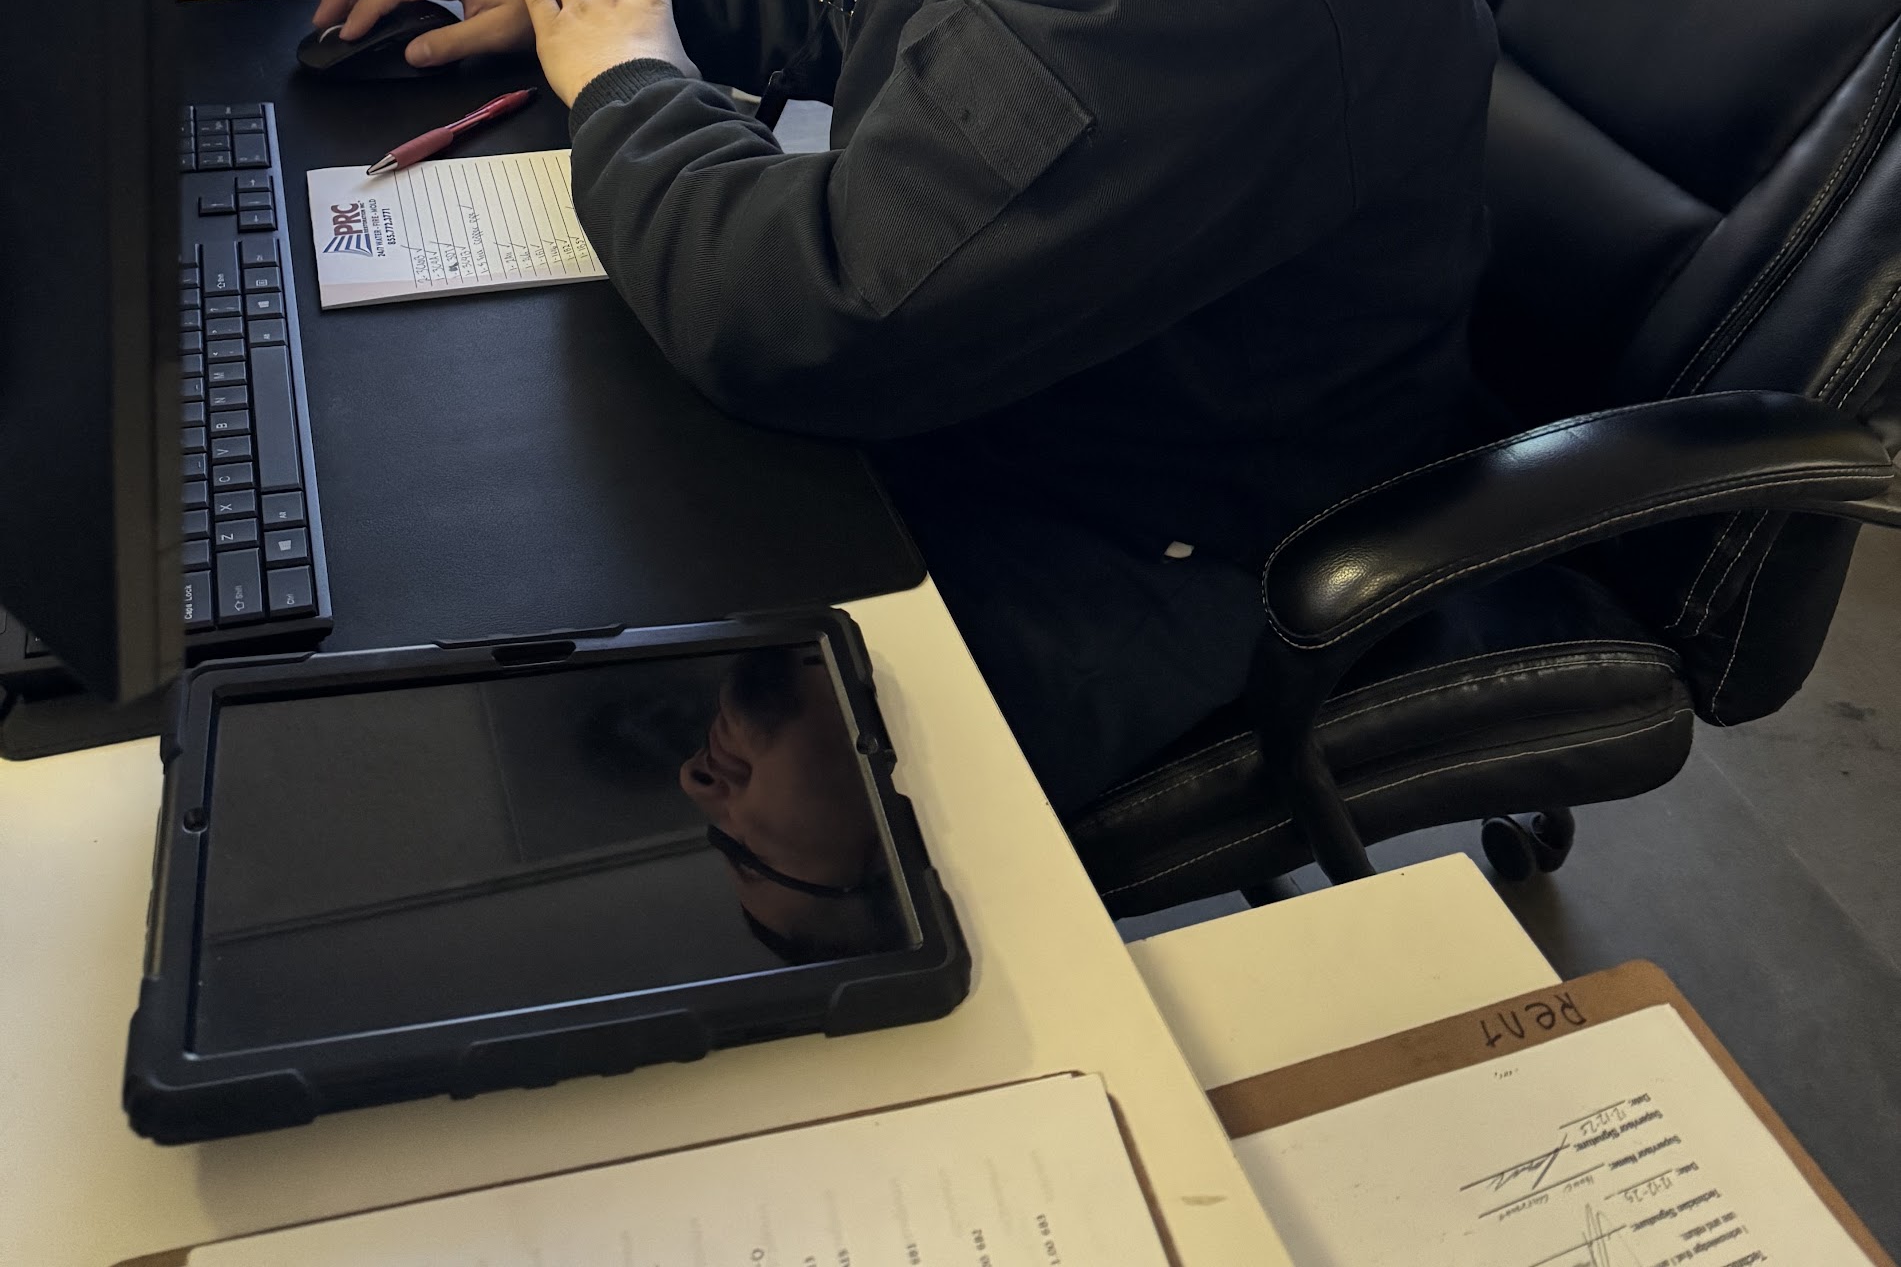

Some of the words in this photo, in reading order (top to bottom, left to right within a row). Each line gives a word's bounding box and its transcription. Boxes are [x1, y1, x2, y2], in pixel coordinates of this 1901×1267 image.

[368, 199, 378, 212] MOLD
[330, 202, 363, 236] PRC
[372, 216, 380, 226] FIRE
[374, 230, 384, 246] WATER
[1619, 1109, 1664, 1134] Supervisor
[1637, 1135, 1682, 1159] Supervisor
